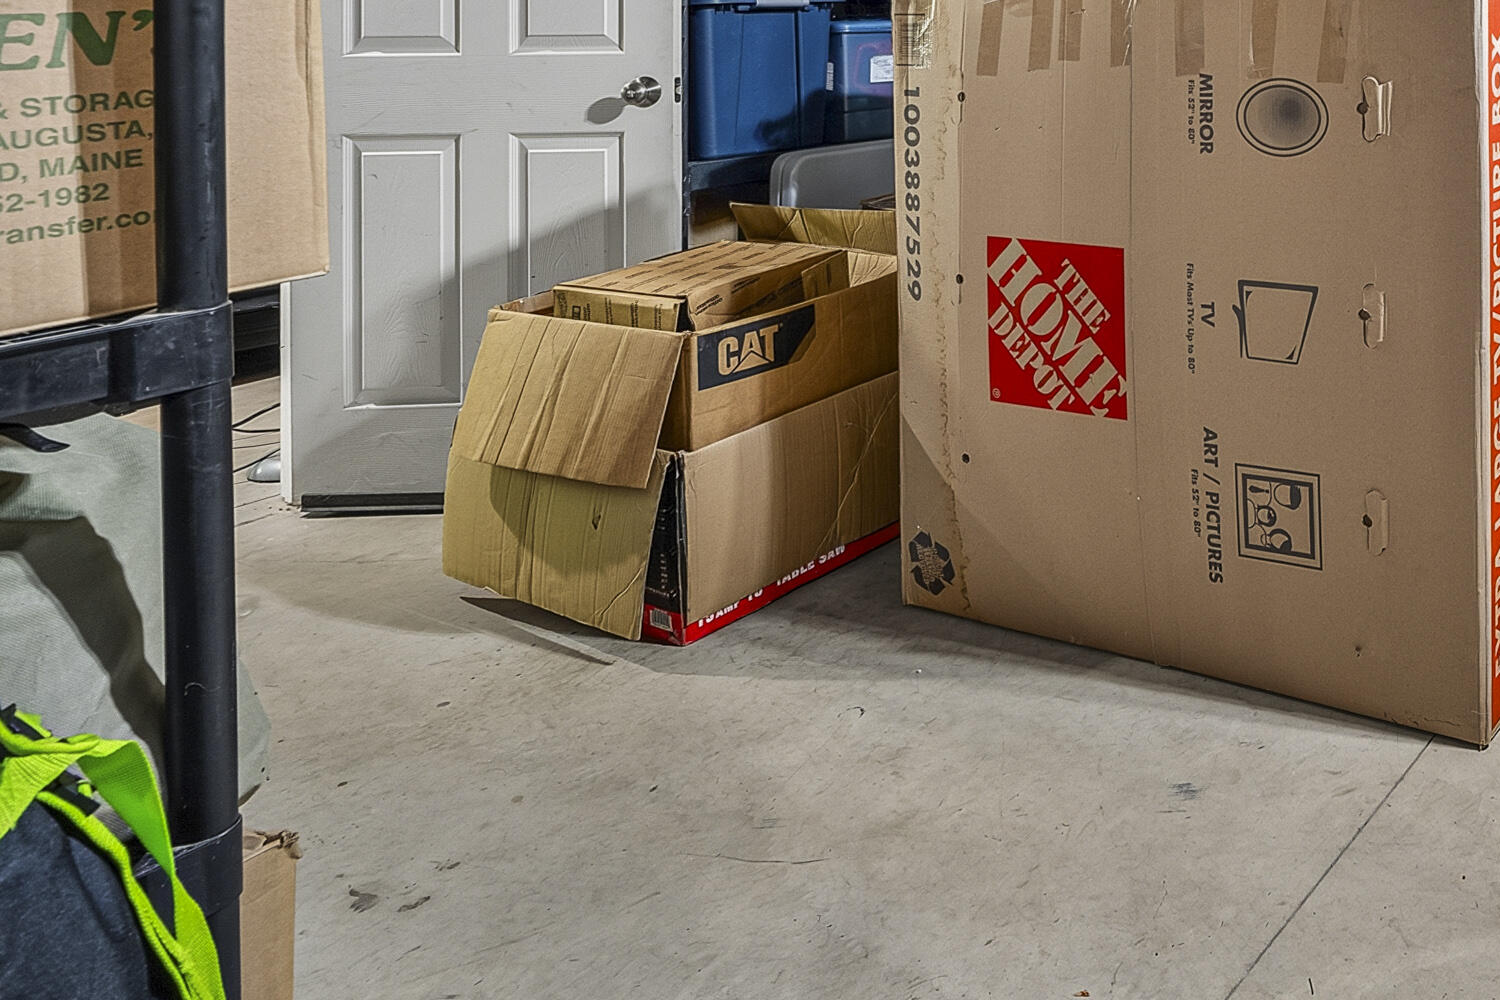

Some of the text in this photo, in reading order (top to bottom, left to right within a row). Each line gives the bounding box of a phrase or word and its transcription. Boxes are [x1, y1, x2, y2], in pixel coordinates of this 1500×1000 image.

[0, 10, 155, 71] EN’
[1187, 79, 1196, 94] Fits
[20, 89, 155, 118] STORAG
[1199, 73, 1215, 154] MIRROR
[1188, 117, 1196, 126] to
[39, 148, 145, 179] MAINE
[0, 182, 111, 214] 2-1982
[903, 86, 923, 301] 1003887529
[0, 209, 156, 245] ansfer.co
[1186, 262, 1195, 279] Fits
[1053, 258, 1112, 335] THE
[1187, 281, 1195, 306] Most
[986, 238, 1128, 418] HOME
[1200, 301, 1216, 328] TV
[717, 324, 781, 377] CAT
[1187, 330, 1196, 342] Up
[987, 302, 1076, 411] DEPOT
[1203, 426, 1220, 468] ART
[1190, 468, 1199, 485] Fits
[1192, 507, 1199, 518] to
[1205, 491, 1224, 584] PICTURES
